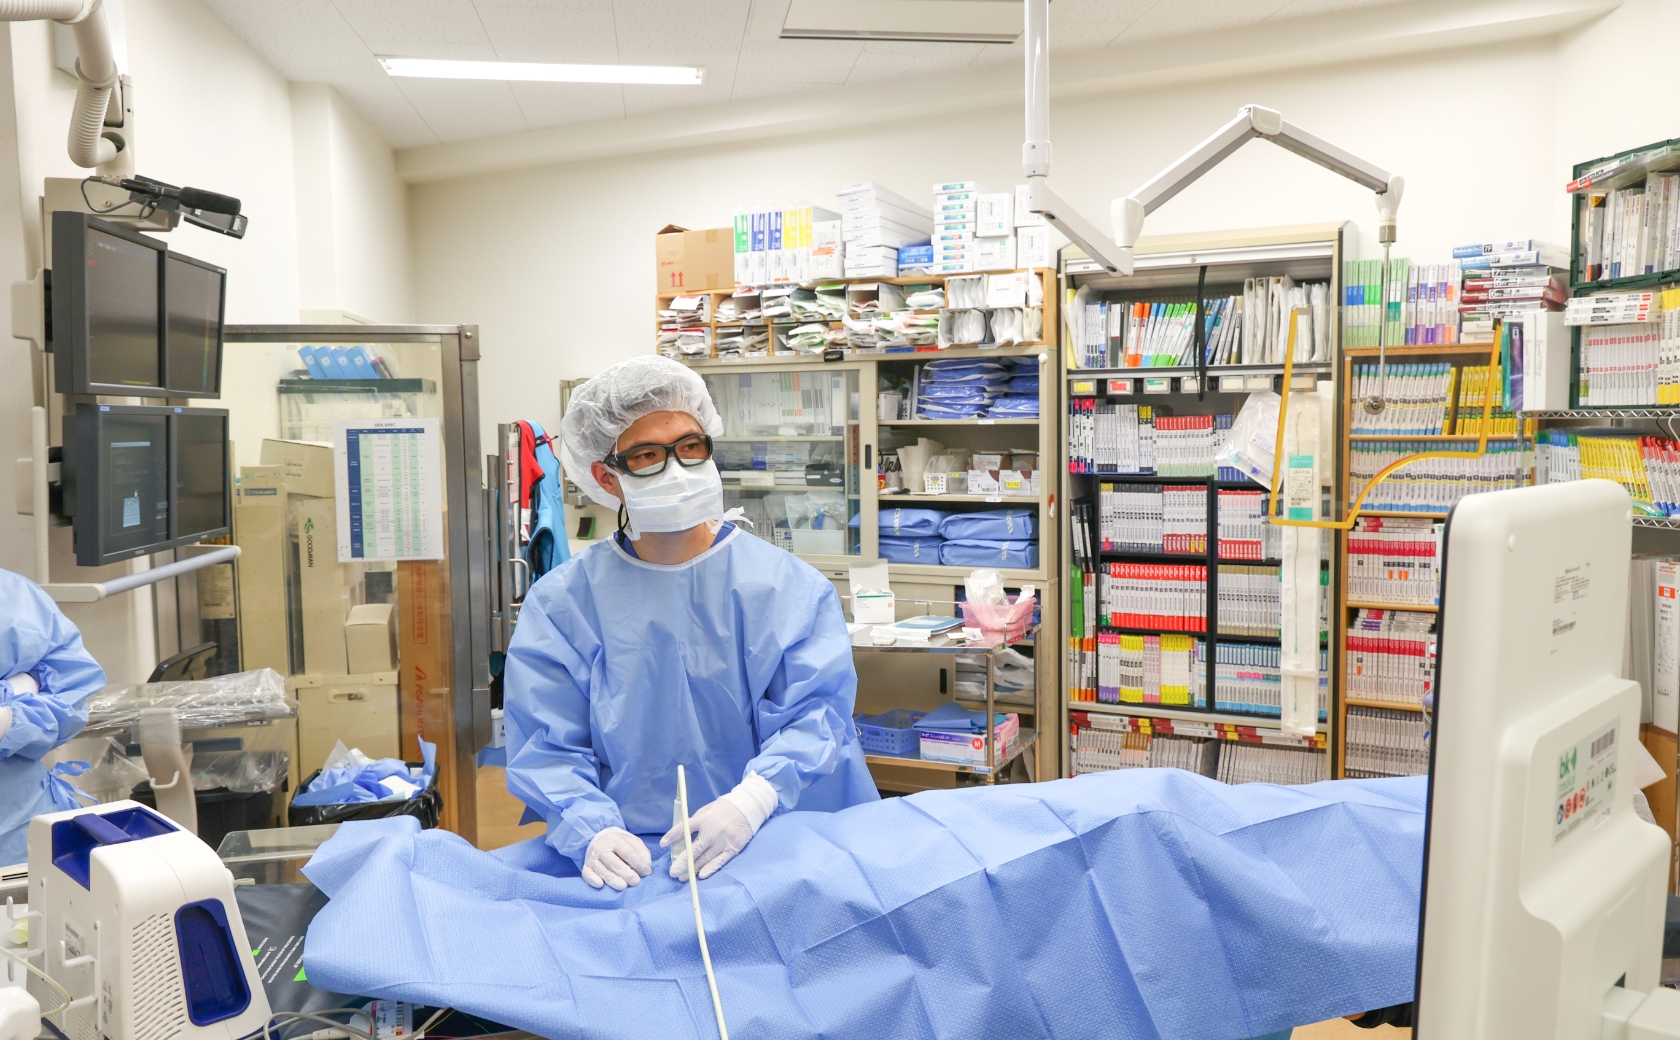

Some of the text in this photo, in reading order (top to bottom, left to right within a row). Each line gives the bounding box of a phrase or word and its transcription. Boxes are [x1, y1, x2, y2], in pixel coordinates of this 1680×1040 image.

[306, 534, 314, 568] GOODMAN
[416, 684, 424, 715] ASAHI
[974, 740, 981, 748] M
